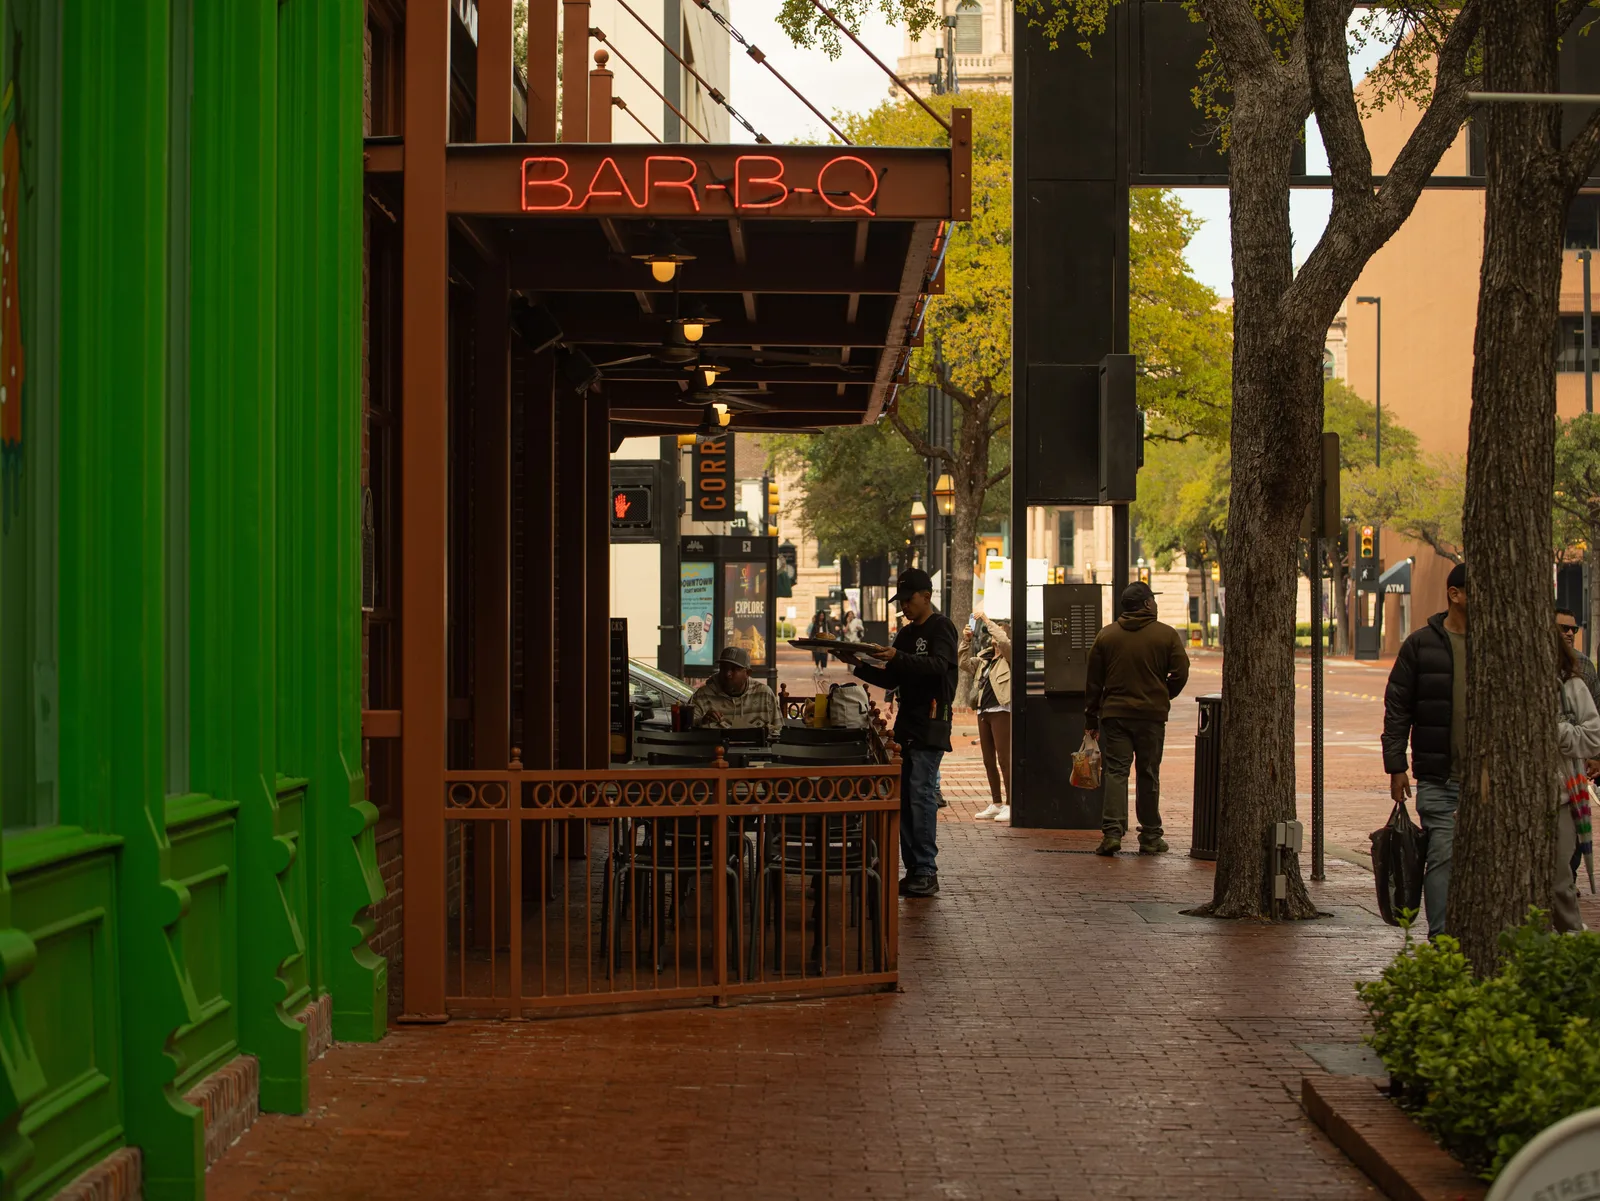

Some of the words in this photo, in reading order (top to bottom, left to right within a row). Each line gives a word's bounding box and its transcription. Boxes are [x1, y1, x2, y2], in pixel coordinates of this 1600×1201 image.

[521, 155, 877, 216] BAR-B-Q
[680, 577, 713, 588] OWNTOWN
[1385, 583, 1405, 593] ATM
[735, 601, 764, 614] EXPLORE
